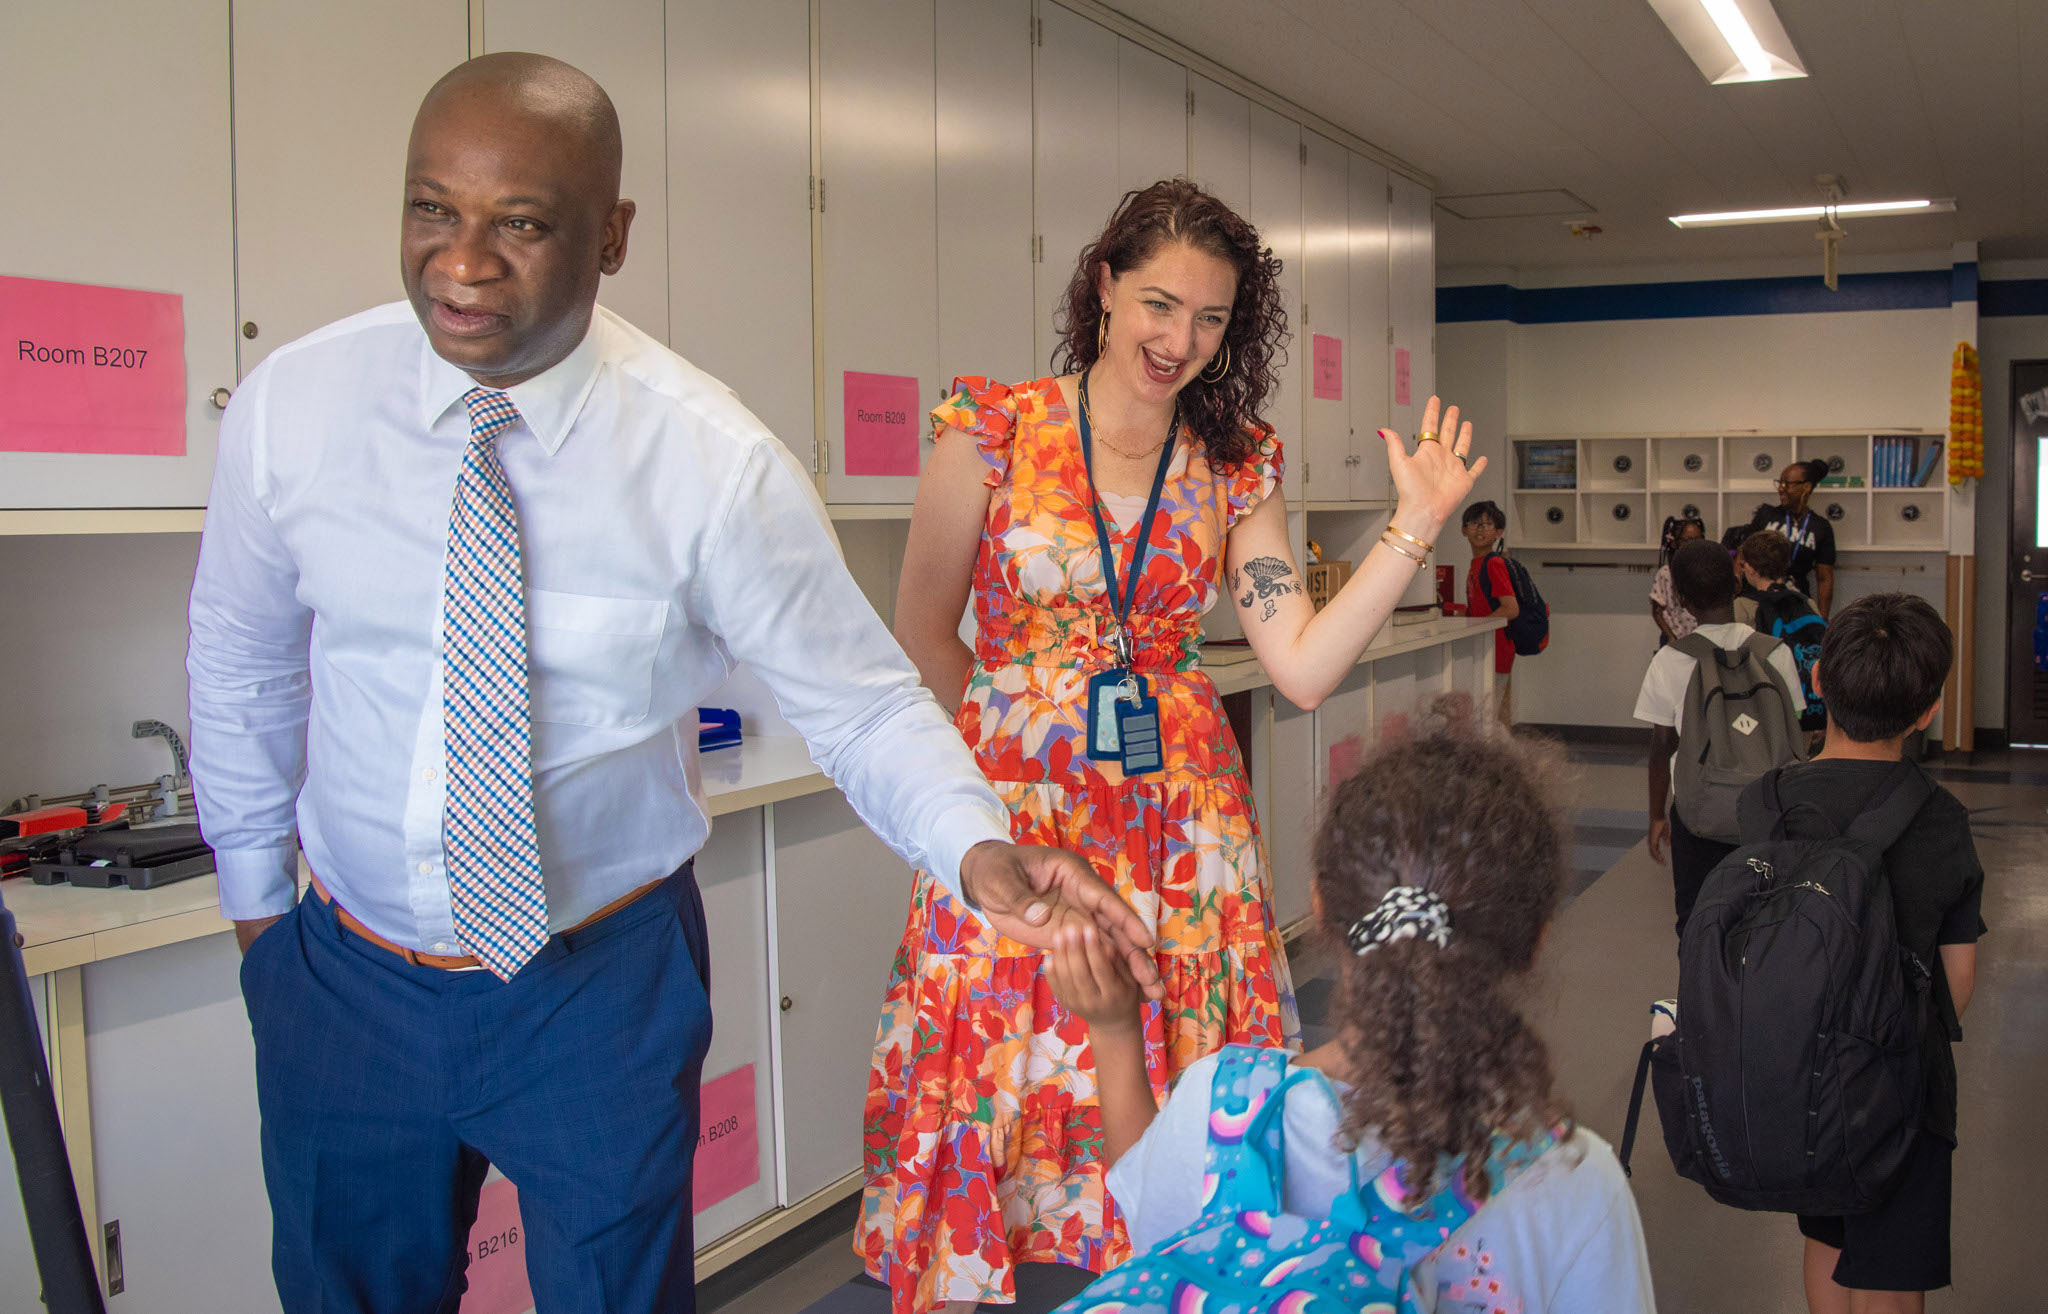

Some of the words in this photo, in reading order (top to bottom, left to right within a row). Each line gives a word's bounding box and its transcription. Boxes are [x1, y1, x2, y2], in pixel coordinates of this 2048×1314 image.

[18, 340, 86, 365] Room
[93, 346, 148, 369] B207
[857, 409, 883, 423] Room
[885, 411, 906, 425] B209
[709, 1115, 739, 1142] B208
[1691, 1075, 1731, 1178] patagonia
[478, 1226, 518, 1260] B216
